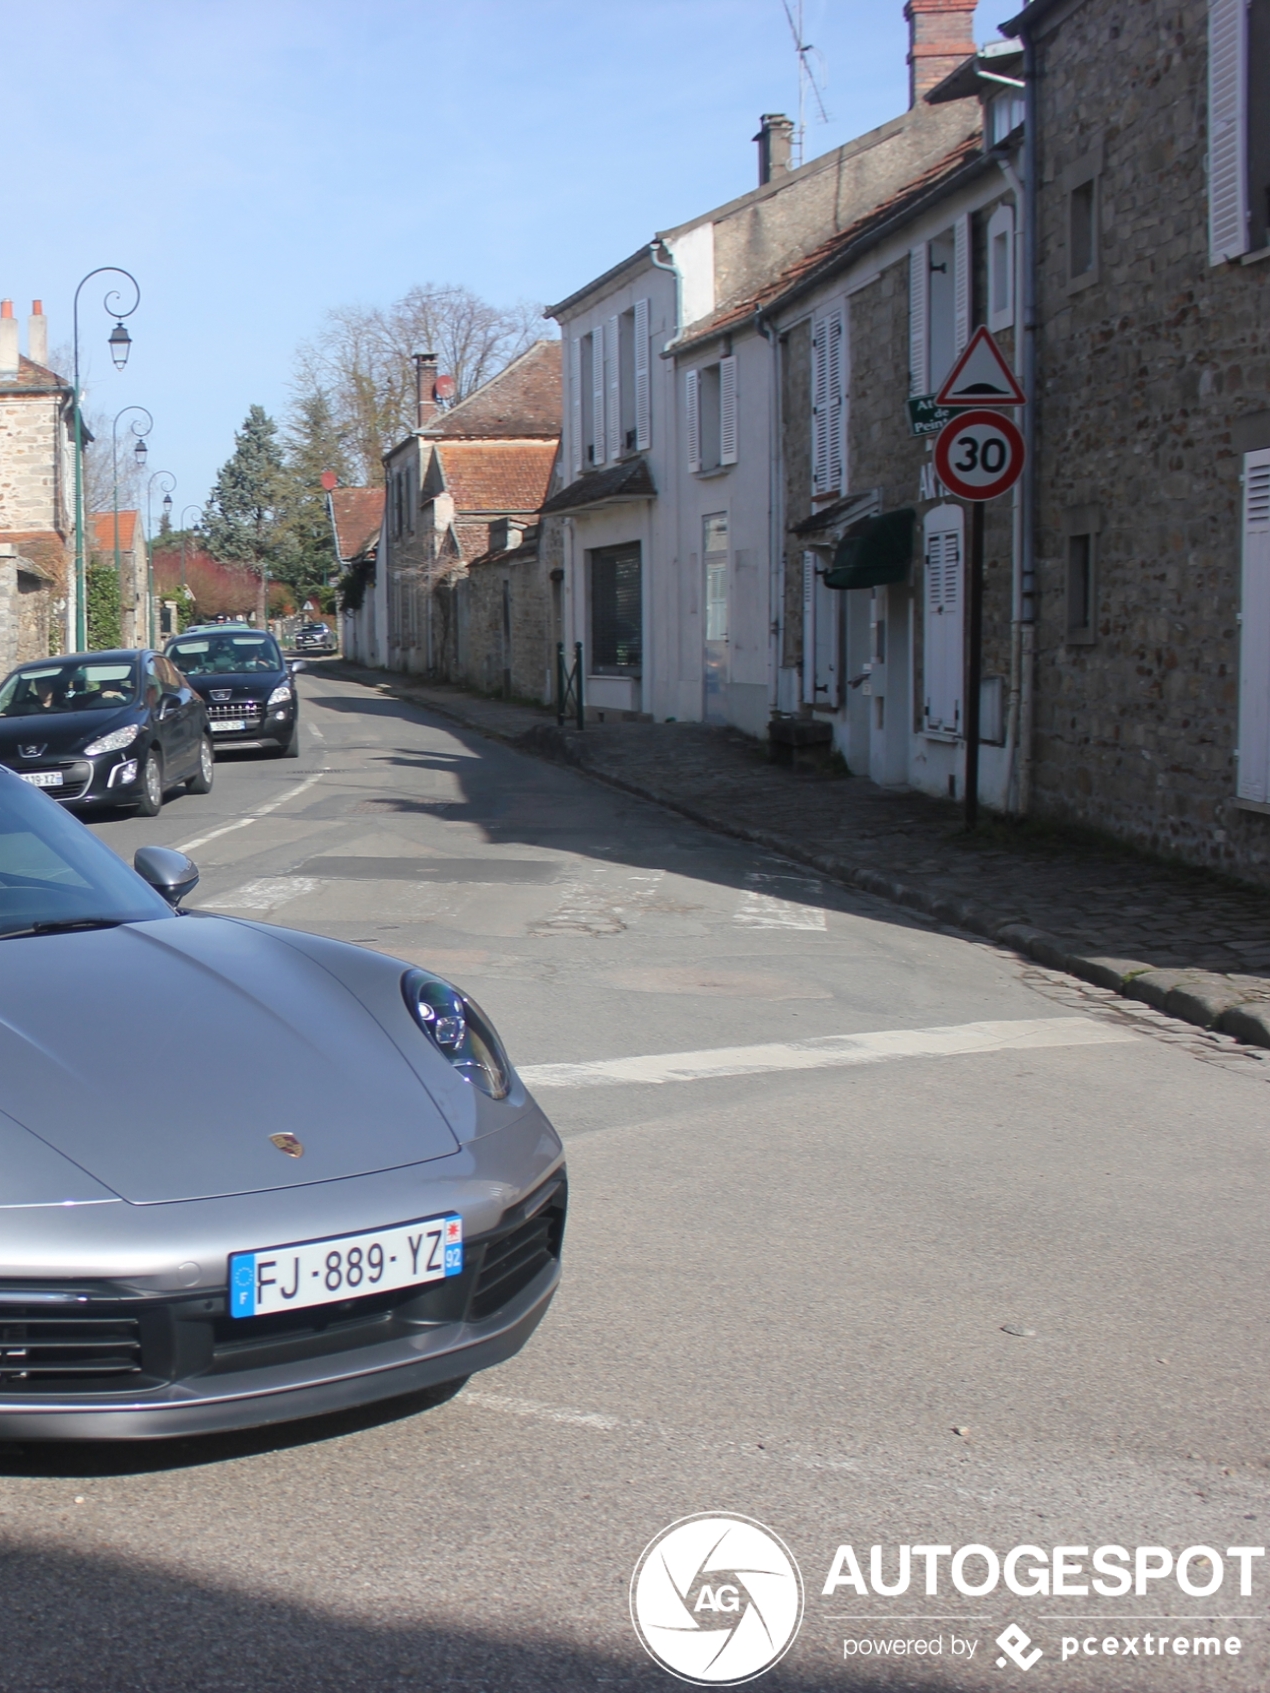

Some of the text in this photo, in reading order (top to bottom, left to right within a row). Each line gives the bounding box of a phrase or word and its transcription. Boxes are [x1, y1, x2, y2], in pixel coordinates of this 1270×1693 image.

[916, 399, 936, 411] At
[934, 408, 949, 418] de
[954, 436, 1007, 474] 30
[257, 1230, 461, 1305] FJ-889-YZ 92
[238, 1292, 247, 1305] F
